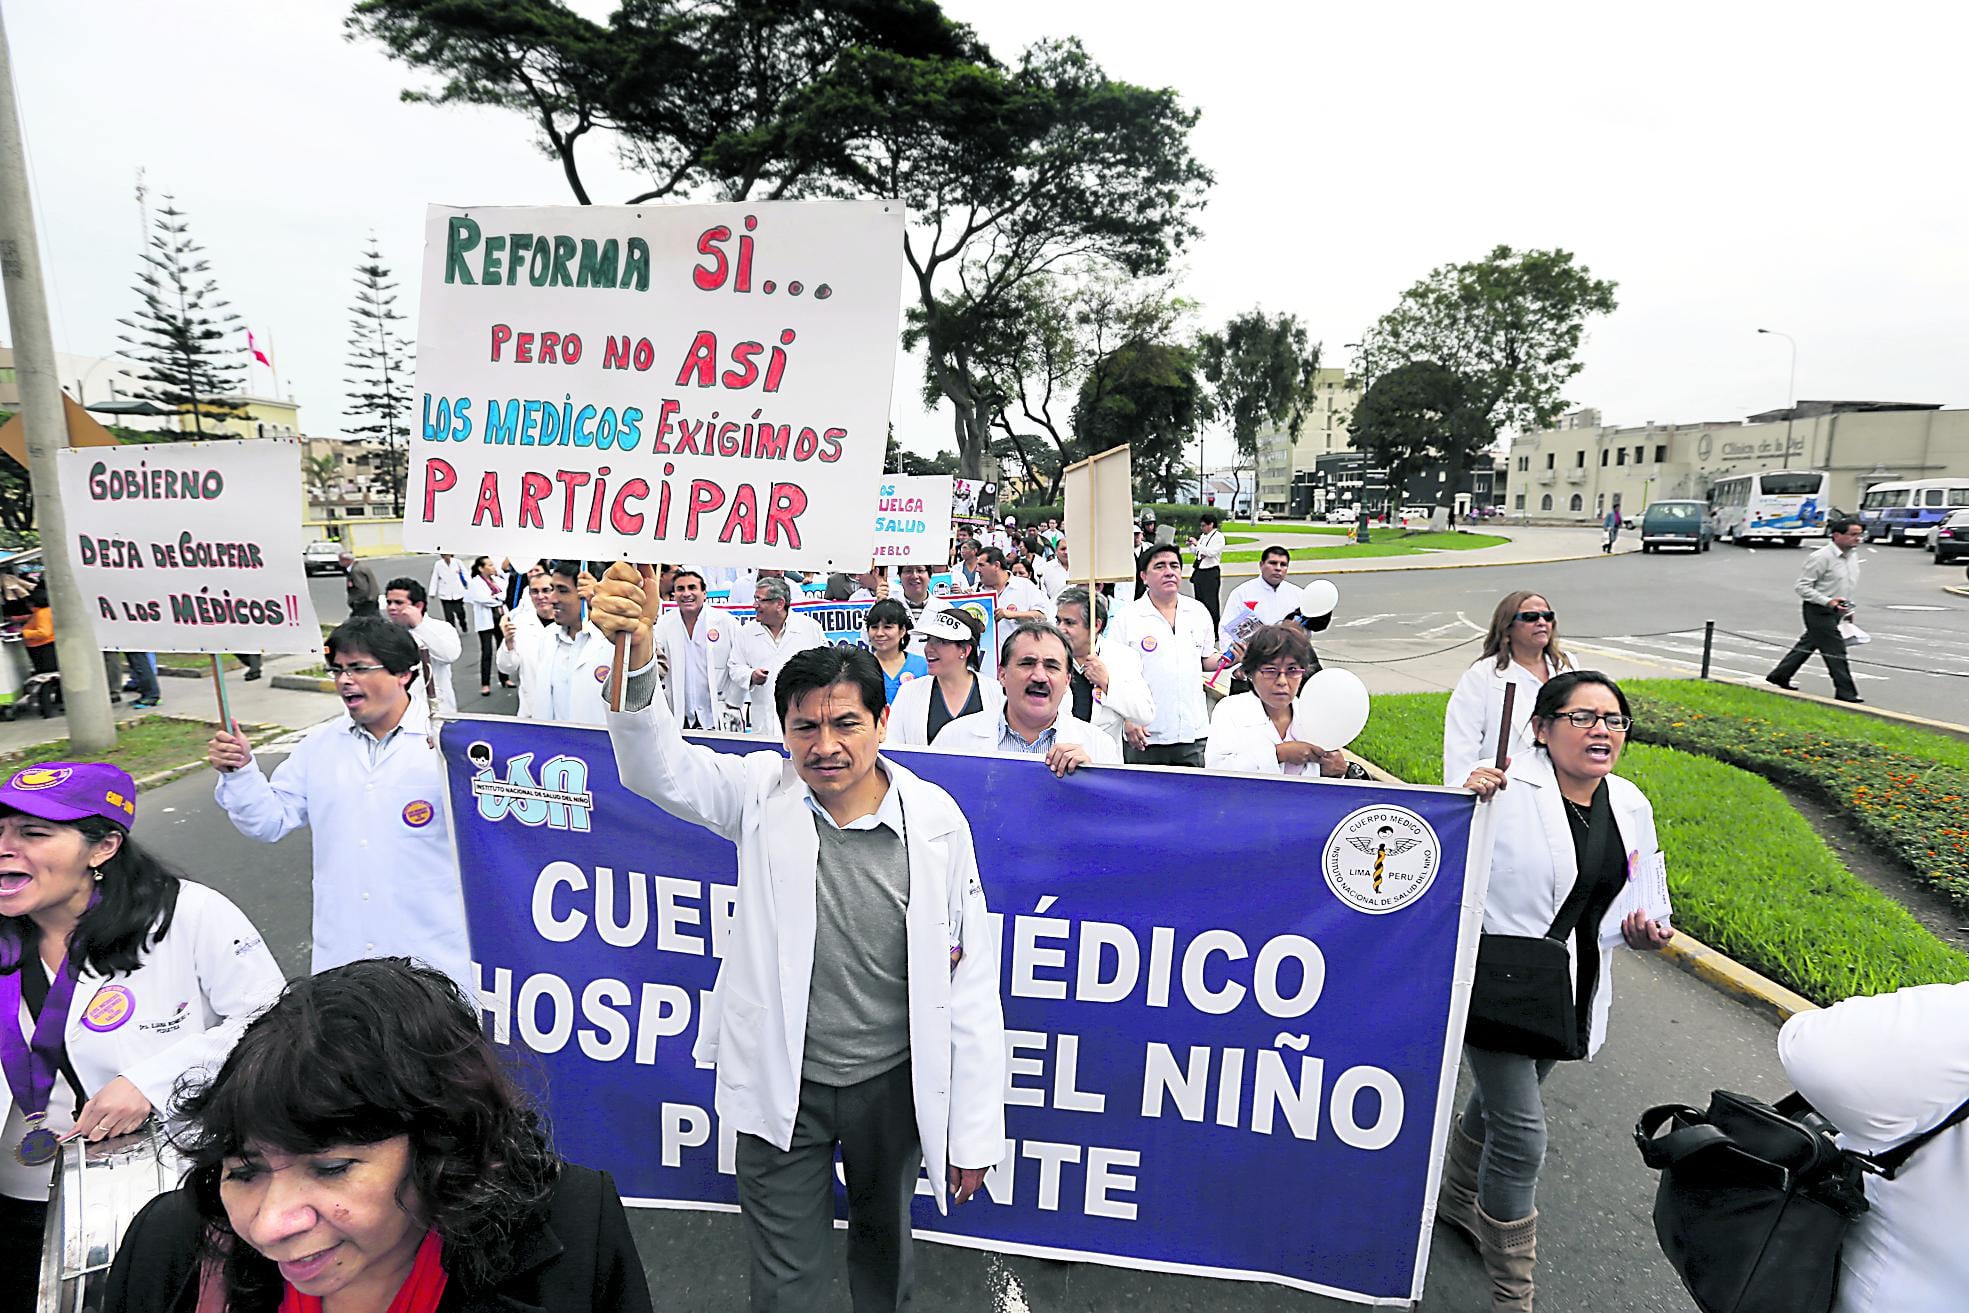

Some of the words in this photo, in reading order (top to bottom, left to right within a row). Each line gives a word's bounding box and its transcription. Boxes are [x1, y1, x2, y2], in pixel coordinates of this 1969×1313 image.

[491, 324, 583, 365] PERO
[602, 335, 655, 372] NO
[421, 392, 473, 443] LOS
[875, 517, 926, 534] SALUD
[79, 533, 144, 569] DEJA
[97, 596, 117, 622] A
[123, 601, 162, 622] LOS
[476, 784, 505, 793] INSTITUTO
[505, 788, 534, 798] NACIONAL
[1349, 814, 1387, 833] CUERPO
[1331, 846, 1344, 883] INSTITUTO
[1340, 882, 1379, 906] NACIONAL
[1381, 898, 1392, 906] DE
[1393, 883, 1418, 903] SALUD
[1416, 871, 1427, 885] DEL
[1141, 1031, 1405, 1151] NIÑO
